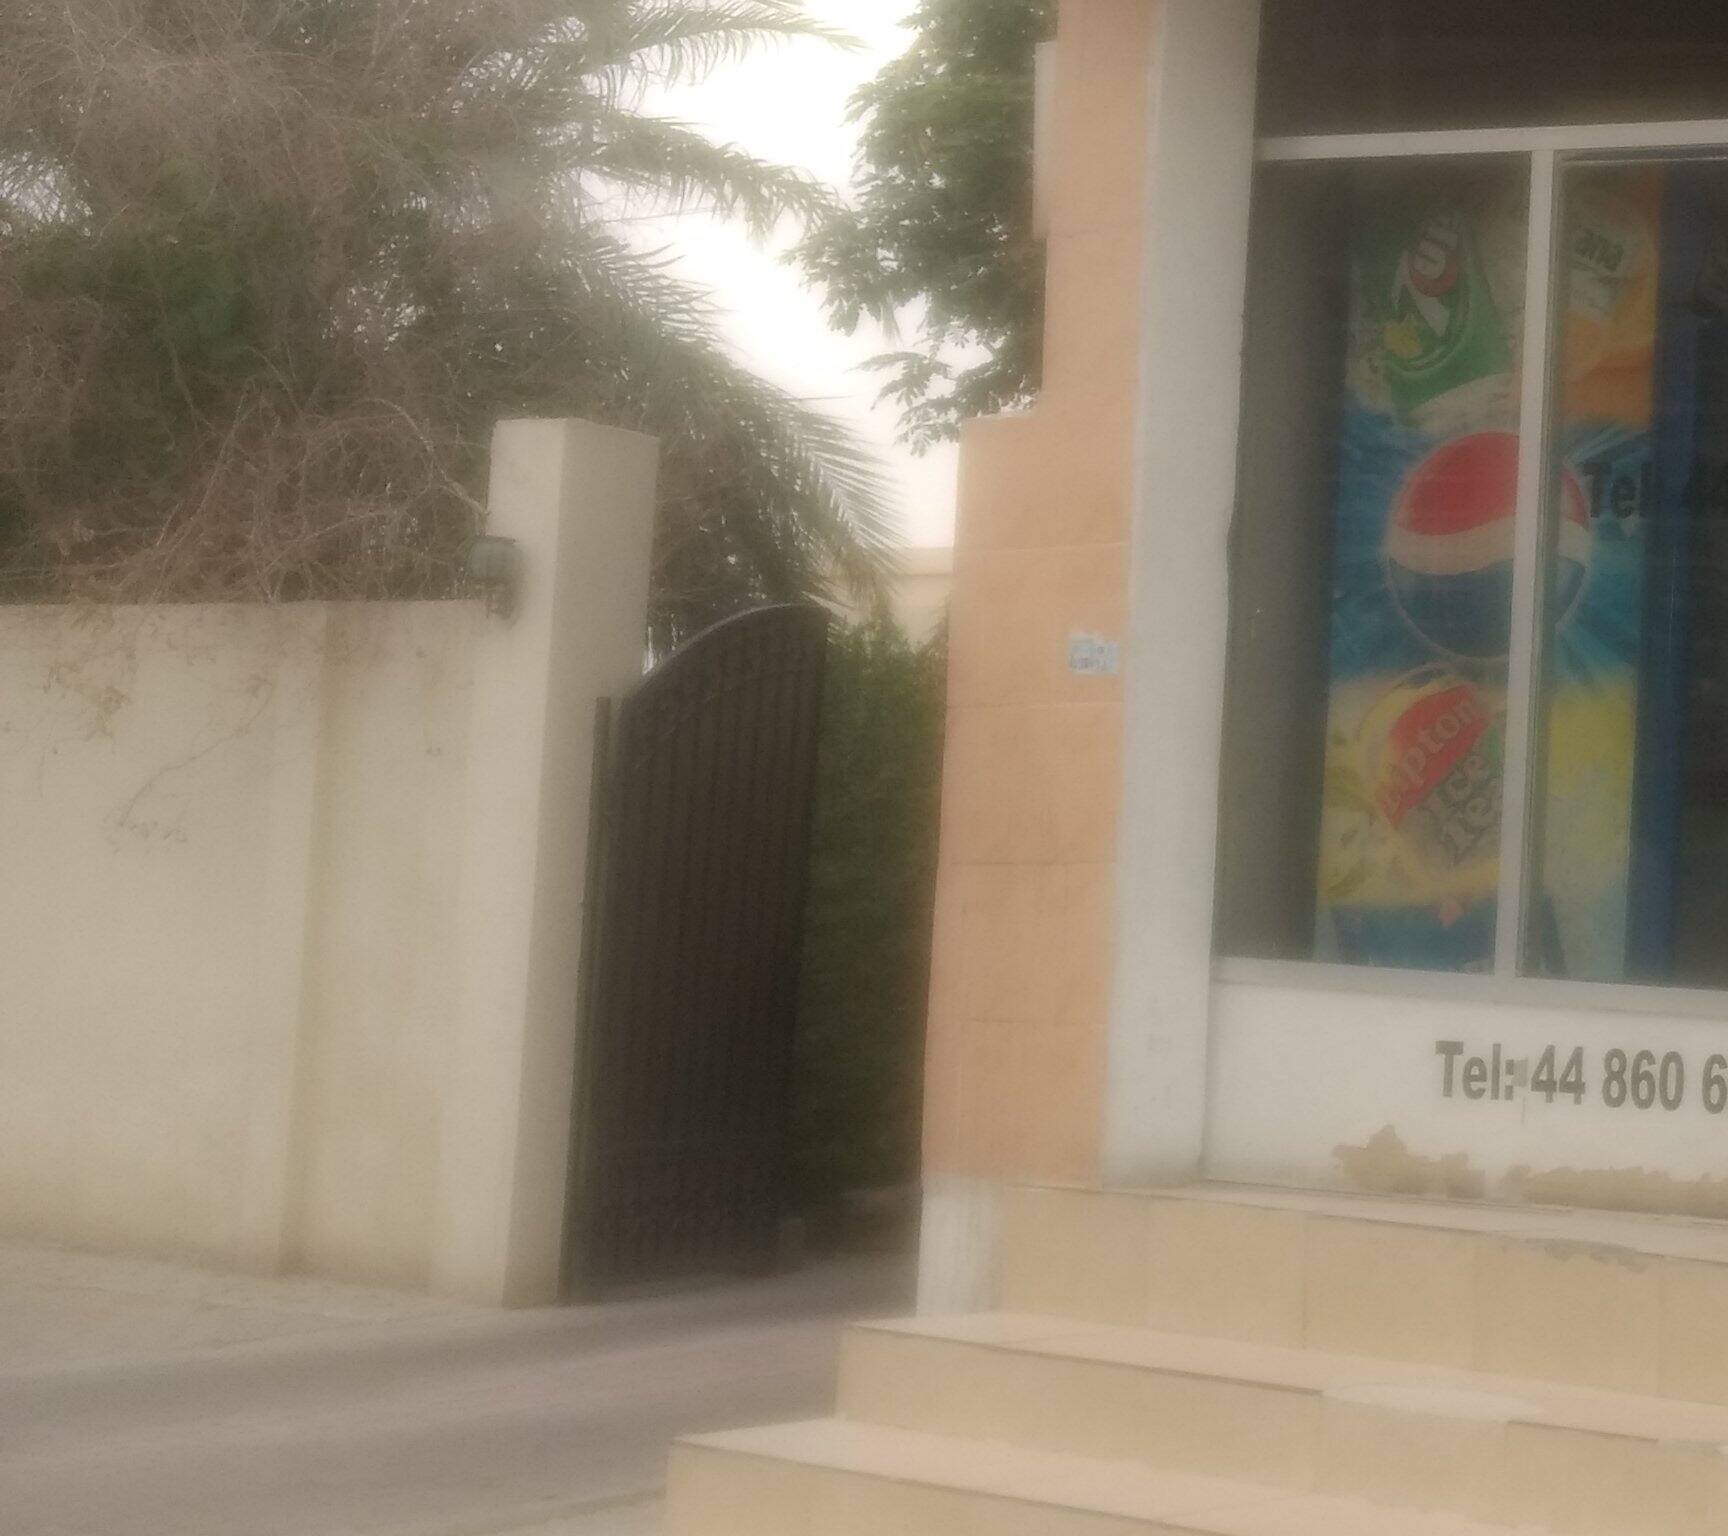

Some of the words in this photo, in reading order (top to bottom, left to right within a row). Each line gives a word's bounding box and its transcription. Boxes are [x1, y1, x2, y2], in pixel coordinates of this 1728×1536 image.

[1435, 1040, 1514, 1101] Tel:
[1530, 1044, 1587, 1105] 44
[1602, 1047, 1685, 1112] 860
